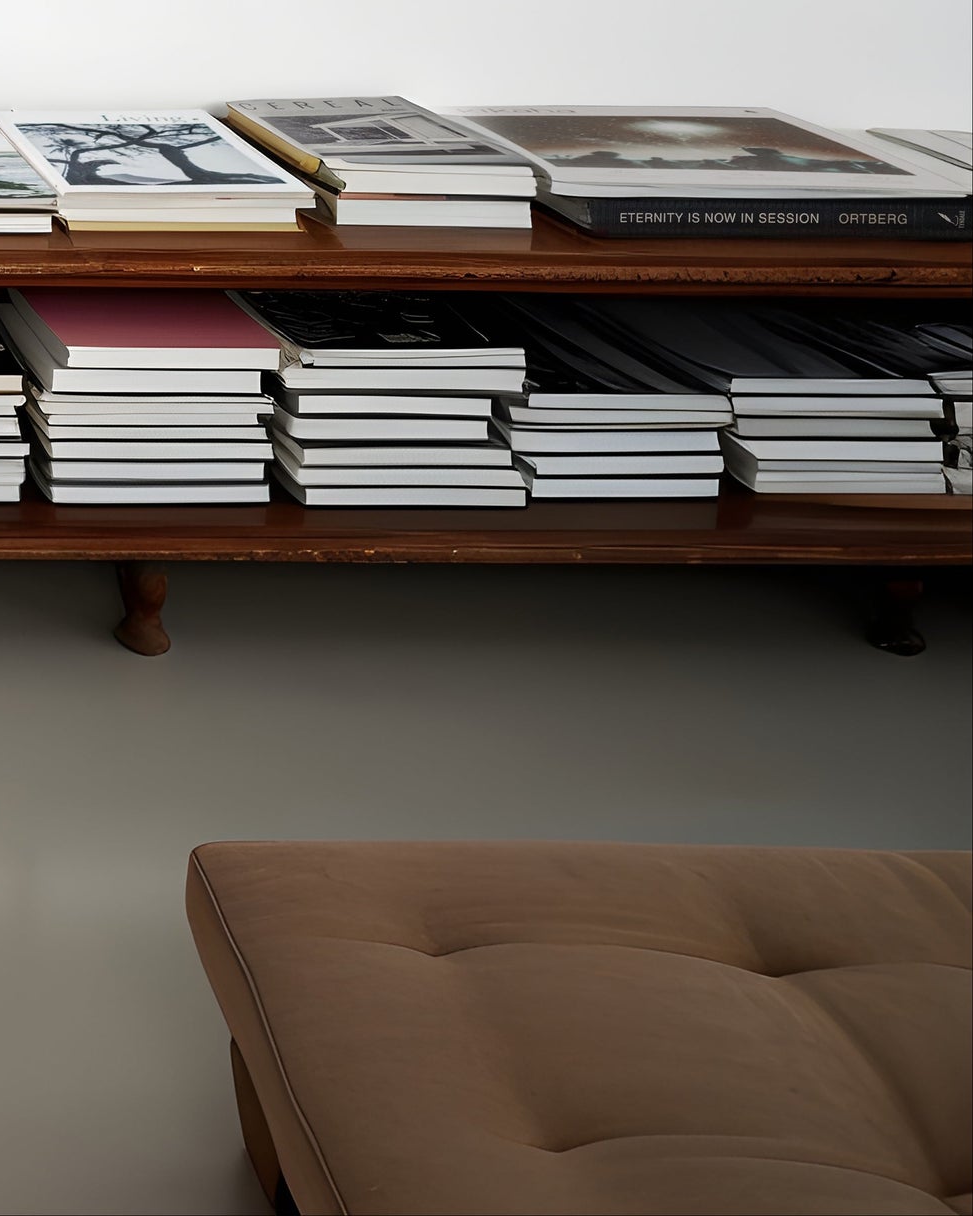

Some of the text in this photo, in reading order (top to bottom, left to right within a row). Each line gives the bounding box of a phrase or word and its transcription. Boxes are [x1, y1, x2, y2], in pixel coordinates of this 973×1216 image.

[237, 97, 402, 111] CEREAL
[619, 212, 820, 224] ETERNITY IS NOW IN SESSION
[838, 212, 908, 225] ORTBERG
